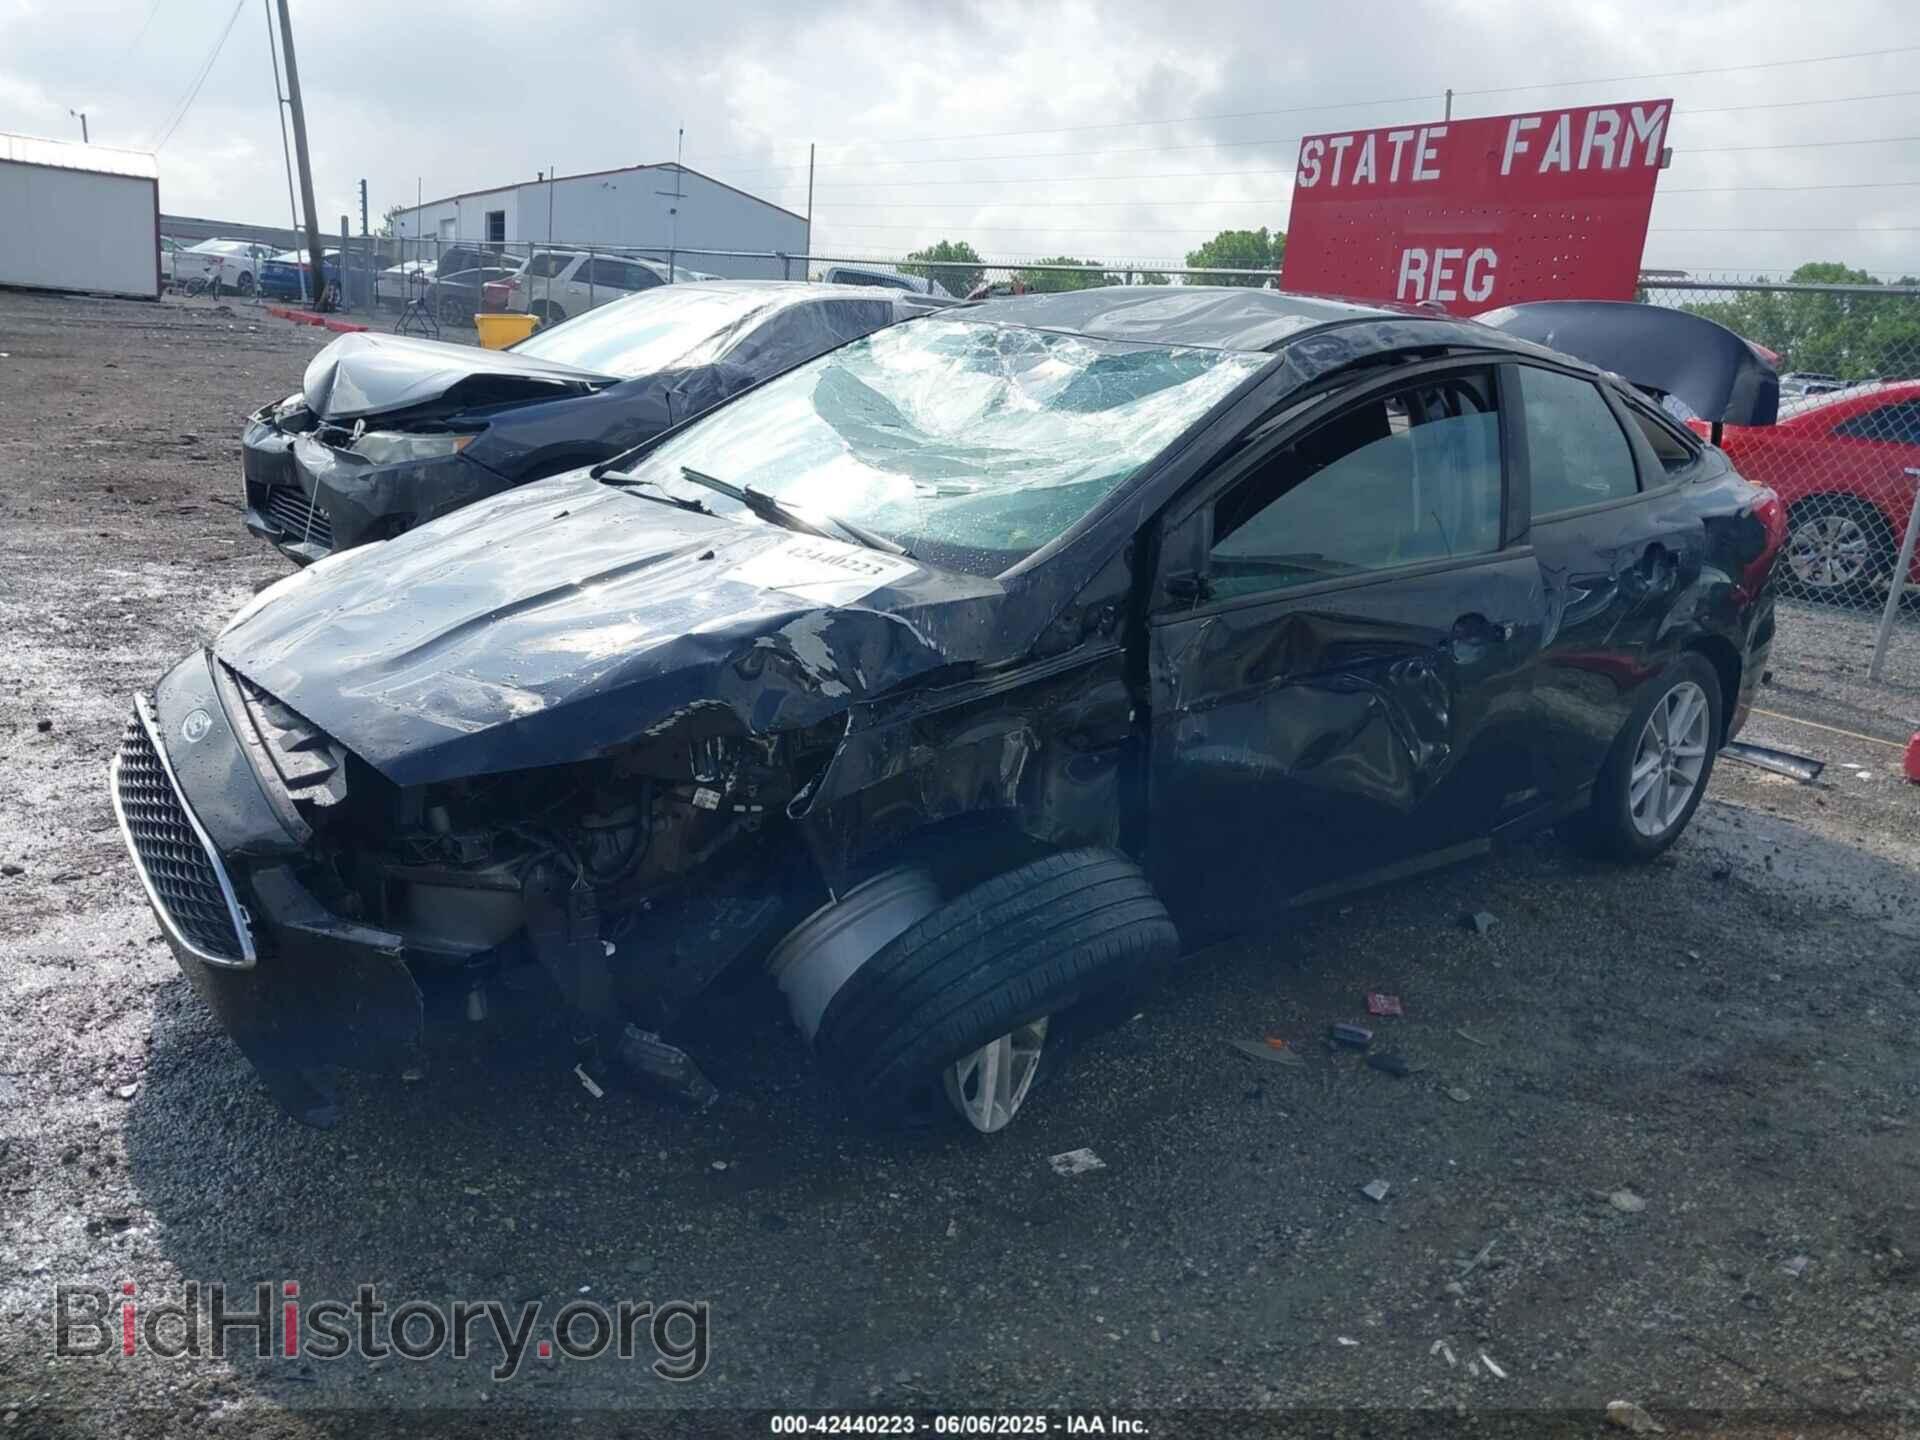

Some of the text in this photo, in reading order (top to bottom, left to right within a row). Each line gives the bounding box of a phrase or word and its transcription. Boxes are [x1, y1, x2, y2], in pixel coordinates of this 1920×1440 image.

[1298, 105, 1667, 188] STATE FARM
[1397, 248, 1497, 302] REG
